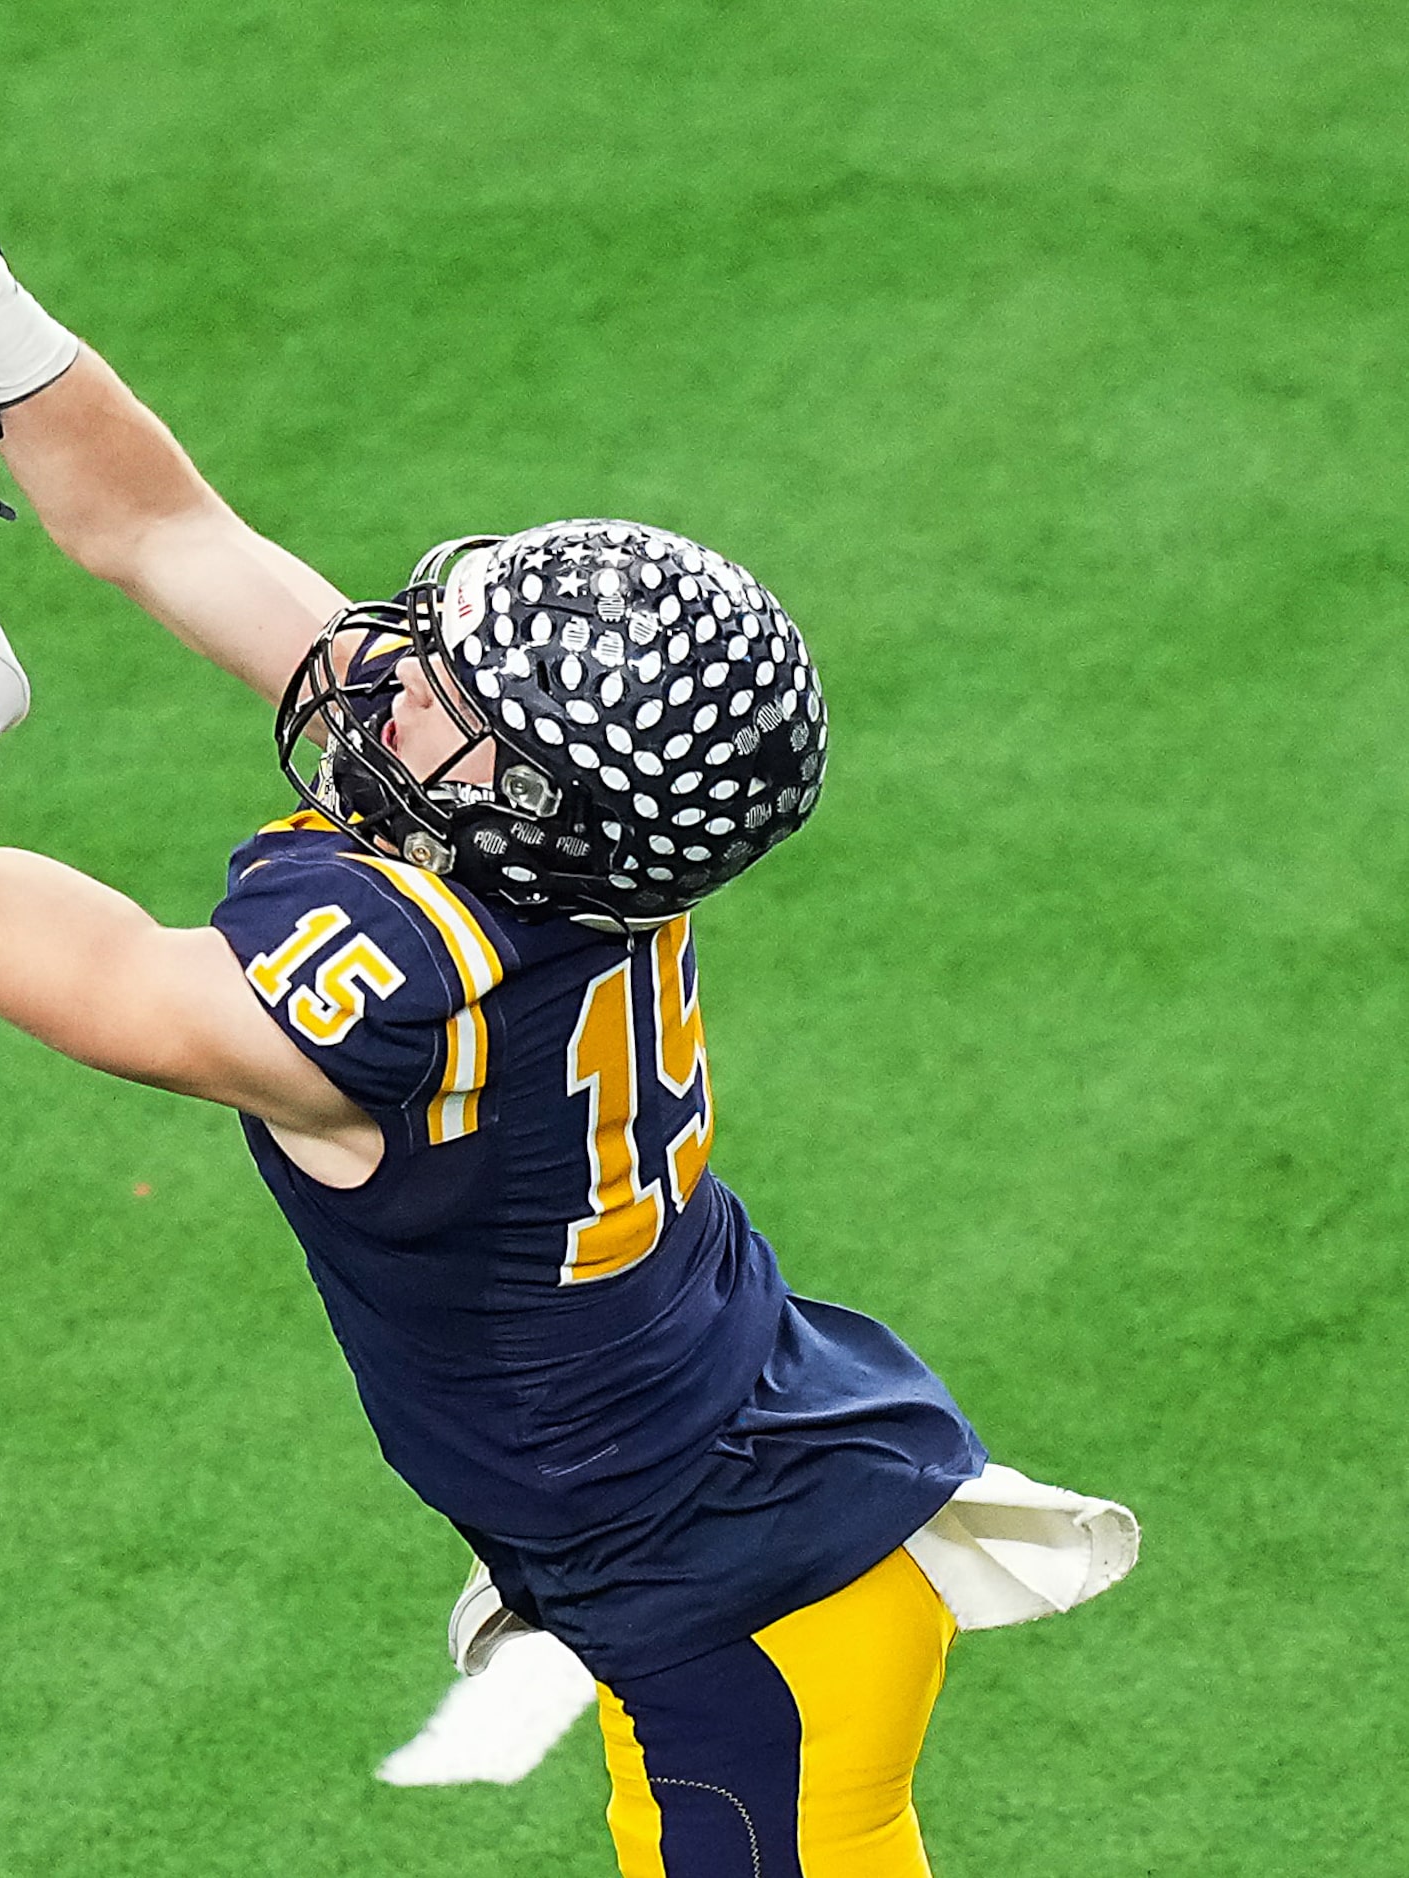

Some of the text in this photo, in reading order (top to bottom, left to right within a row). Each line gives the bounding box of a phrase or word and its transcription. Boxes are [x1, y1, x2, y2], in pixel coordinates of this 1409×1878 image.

[473, 830, 508, 856] PRIDE
[510, 822, 546, 845] PRIDE
[555, 836, 590, 857] PRIDE
[245, 904, 407, 1046] 15
[558, 912, 714, 1287] 15
